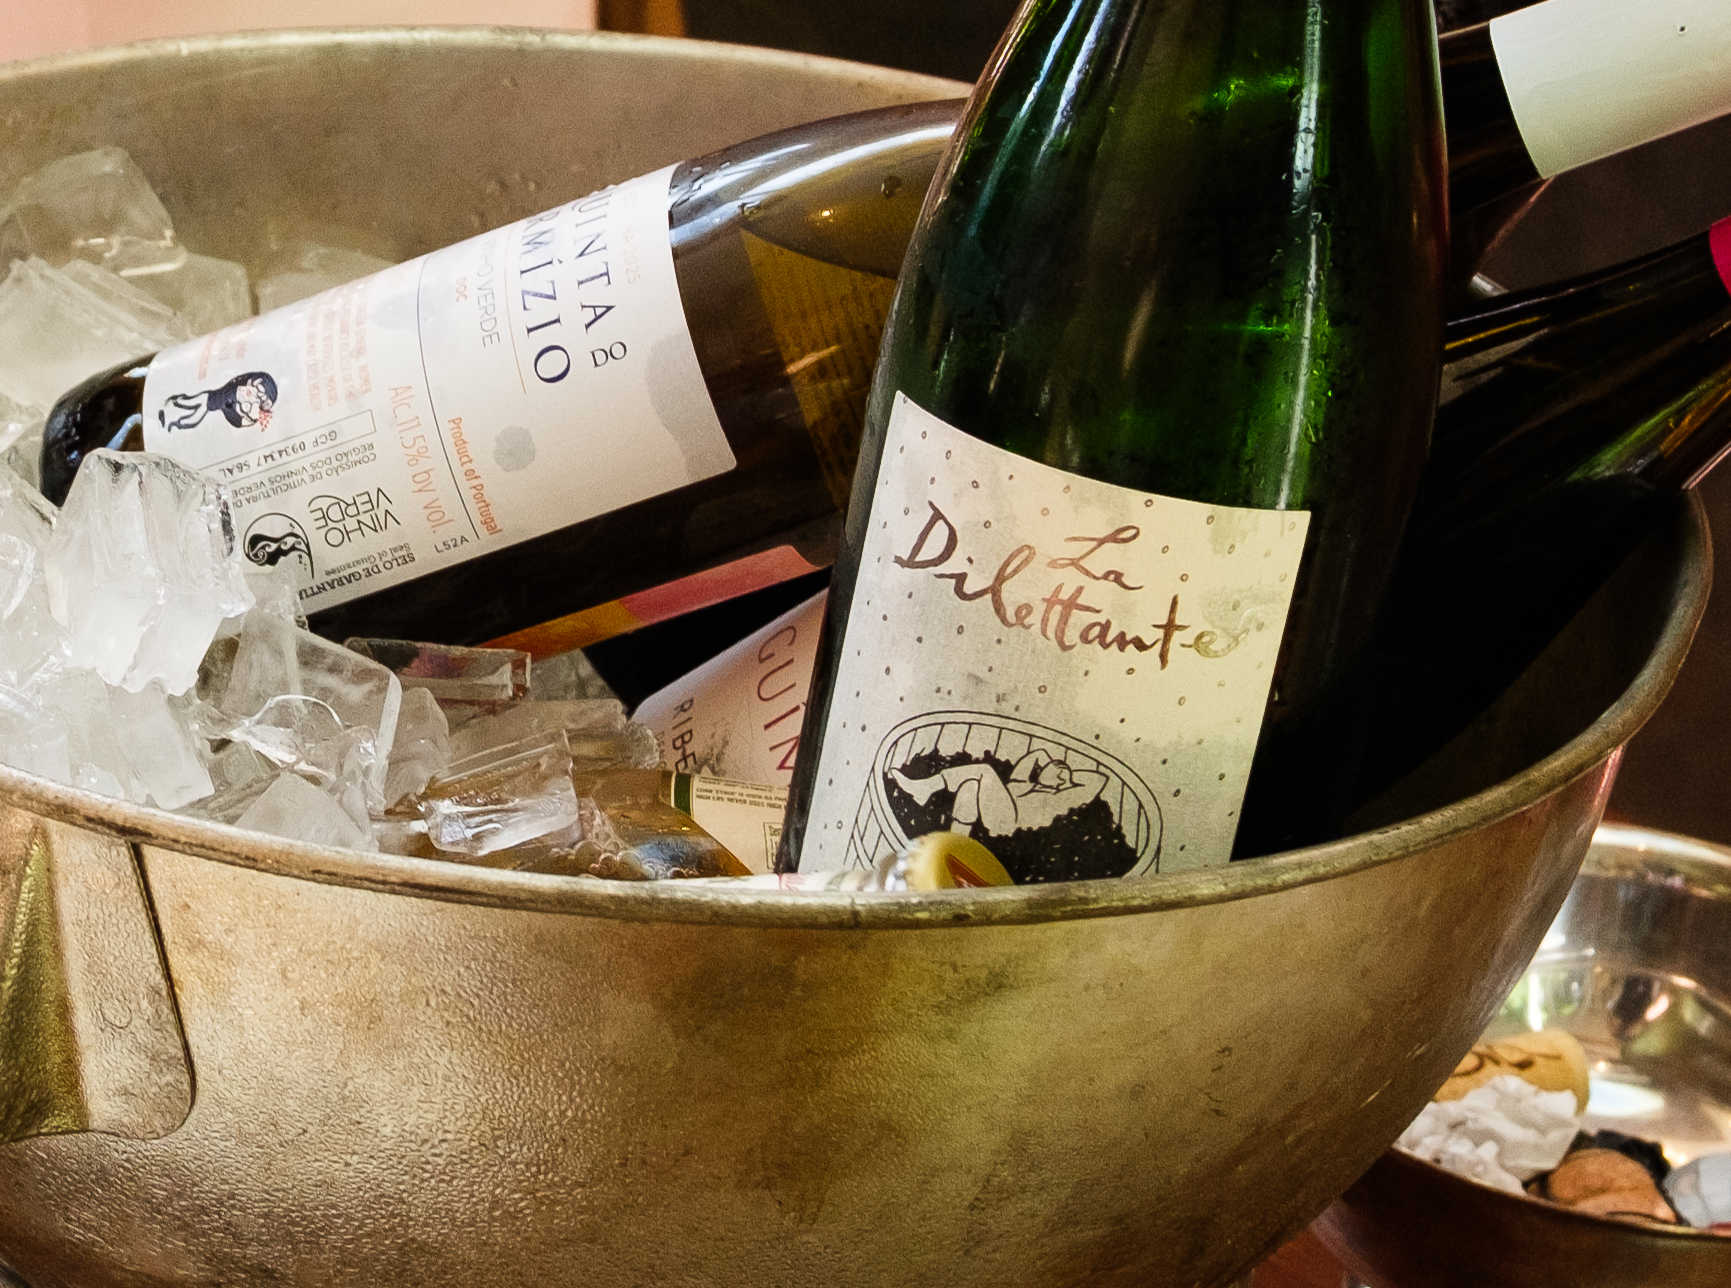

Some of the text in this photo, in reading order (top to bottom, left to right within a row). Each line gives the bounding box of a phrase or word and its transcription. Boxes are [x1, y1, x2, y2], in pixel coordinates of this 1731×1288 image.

[476, 277, 501, 348] VERDE
[590, 341, 628, 368] DO
[410, 467, 437, 494] by
[446, 415, 503, 537] Product of Portugal
[307, 486, 392, 530] VERDE
[421, 498, 455, 534] vol.
[321, 508, 401, 549] VINHO
[323, 553, 376, 577] Guarantee
[381, 551, 416, 571] SELO
[388, 541, 411, 558] Seal
[1047, 525, 1145, 591] La
[360, 563, 381, 579] DE
[893, 500, 1249, 671] Dilettante
